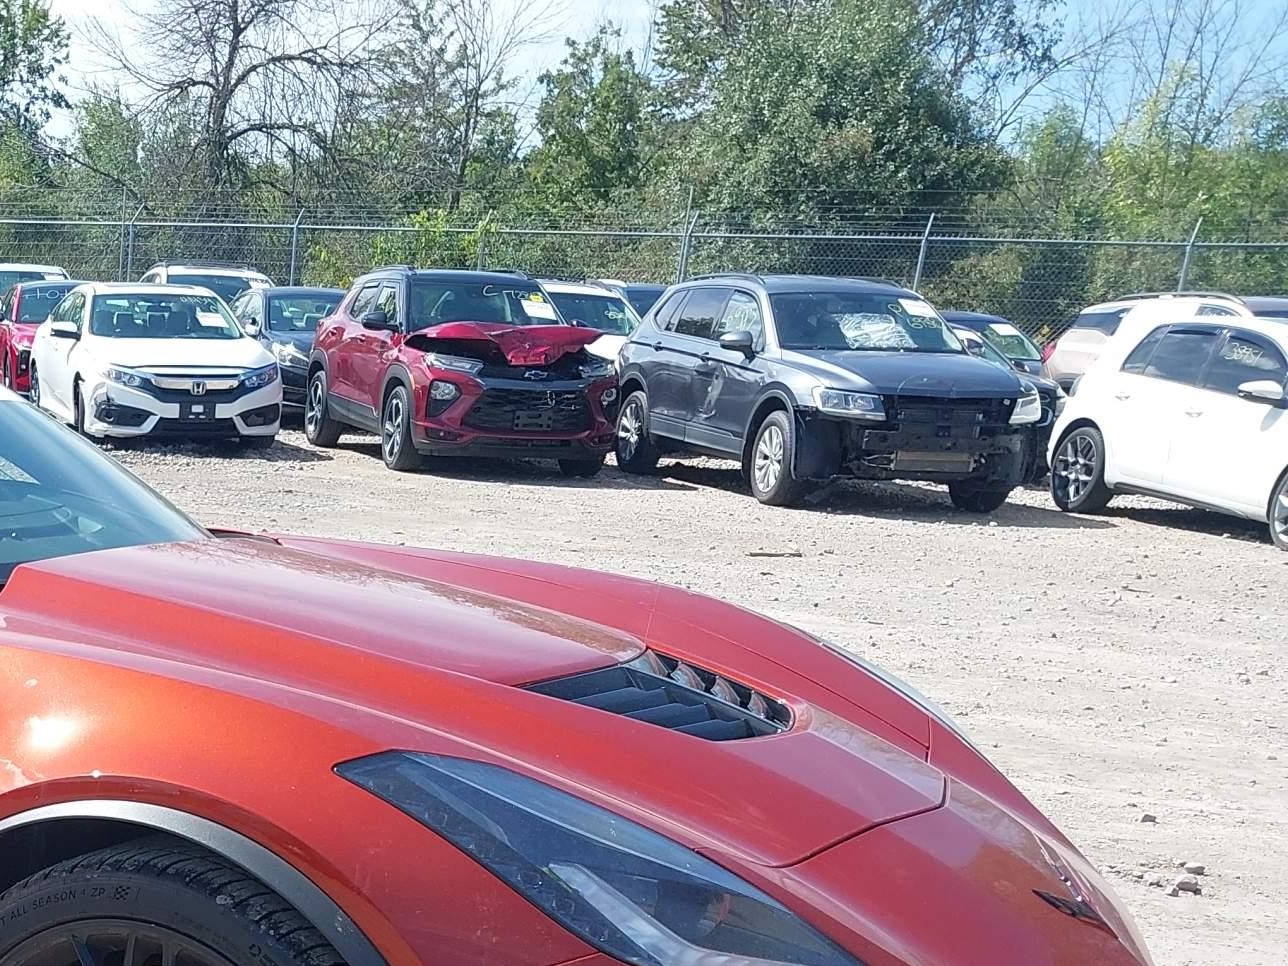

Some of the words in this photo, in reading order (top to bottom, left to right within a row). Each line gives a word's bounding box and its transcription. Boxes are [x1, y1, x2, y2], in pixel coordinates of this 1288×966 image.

[10, 904, 29, 921] ALL
[32, 889, 77, 910] SEASON
[90, 887, 107, 898] ZP
